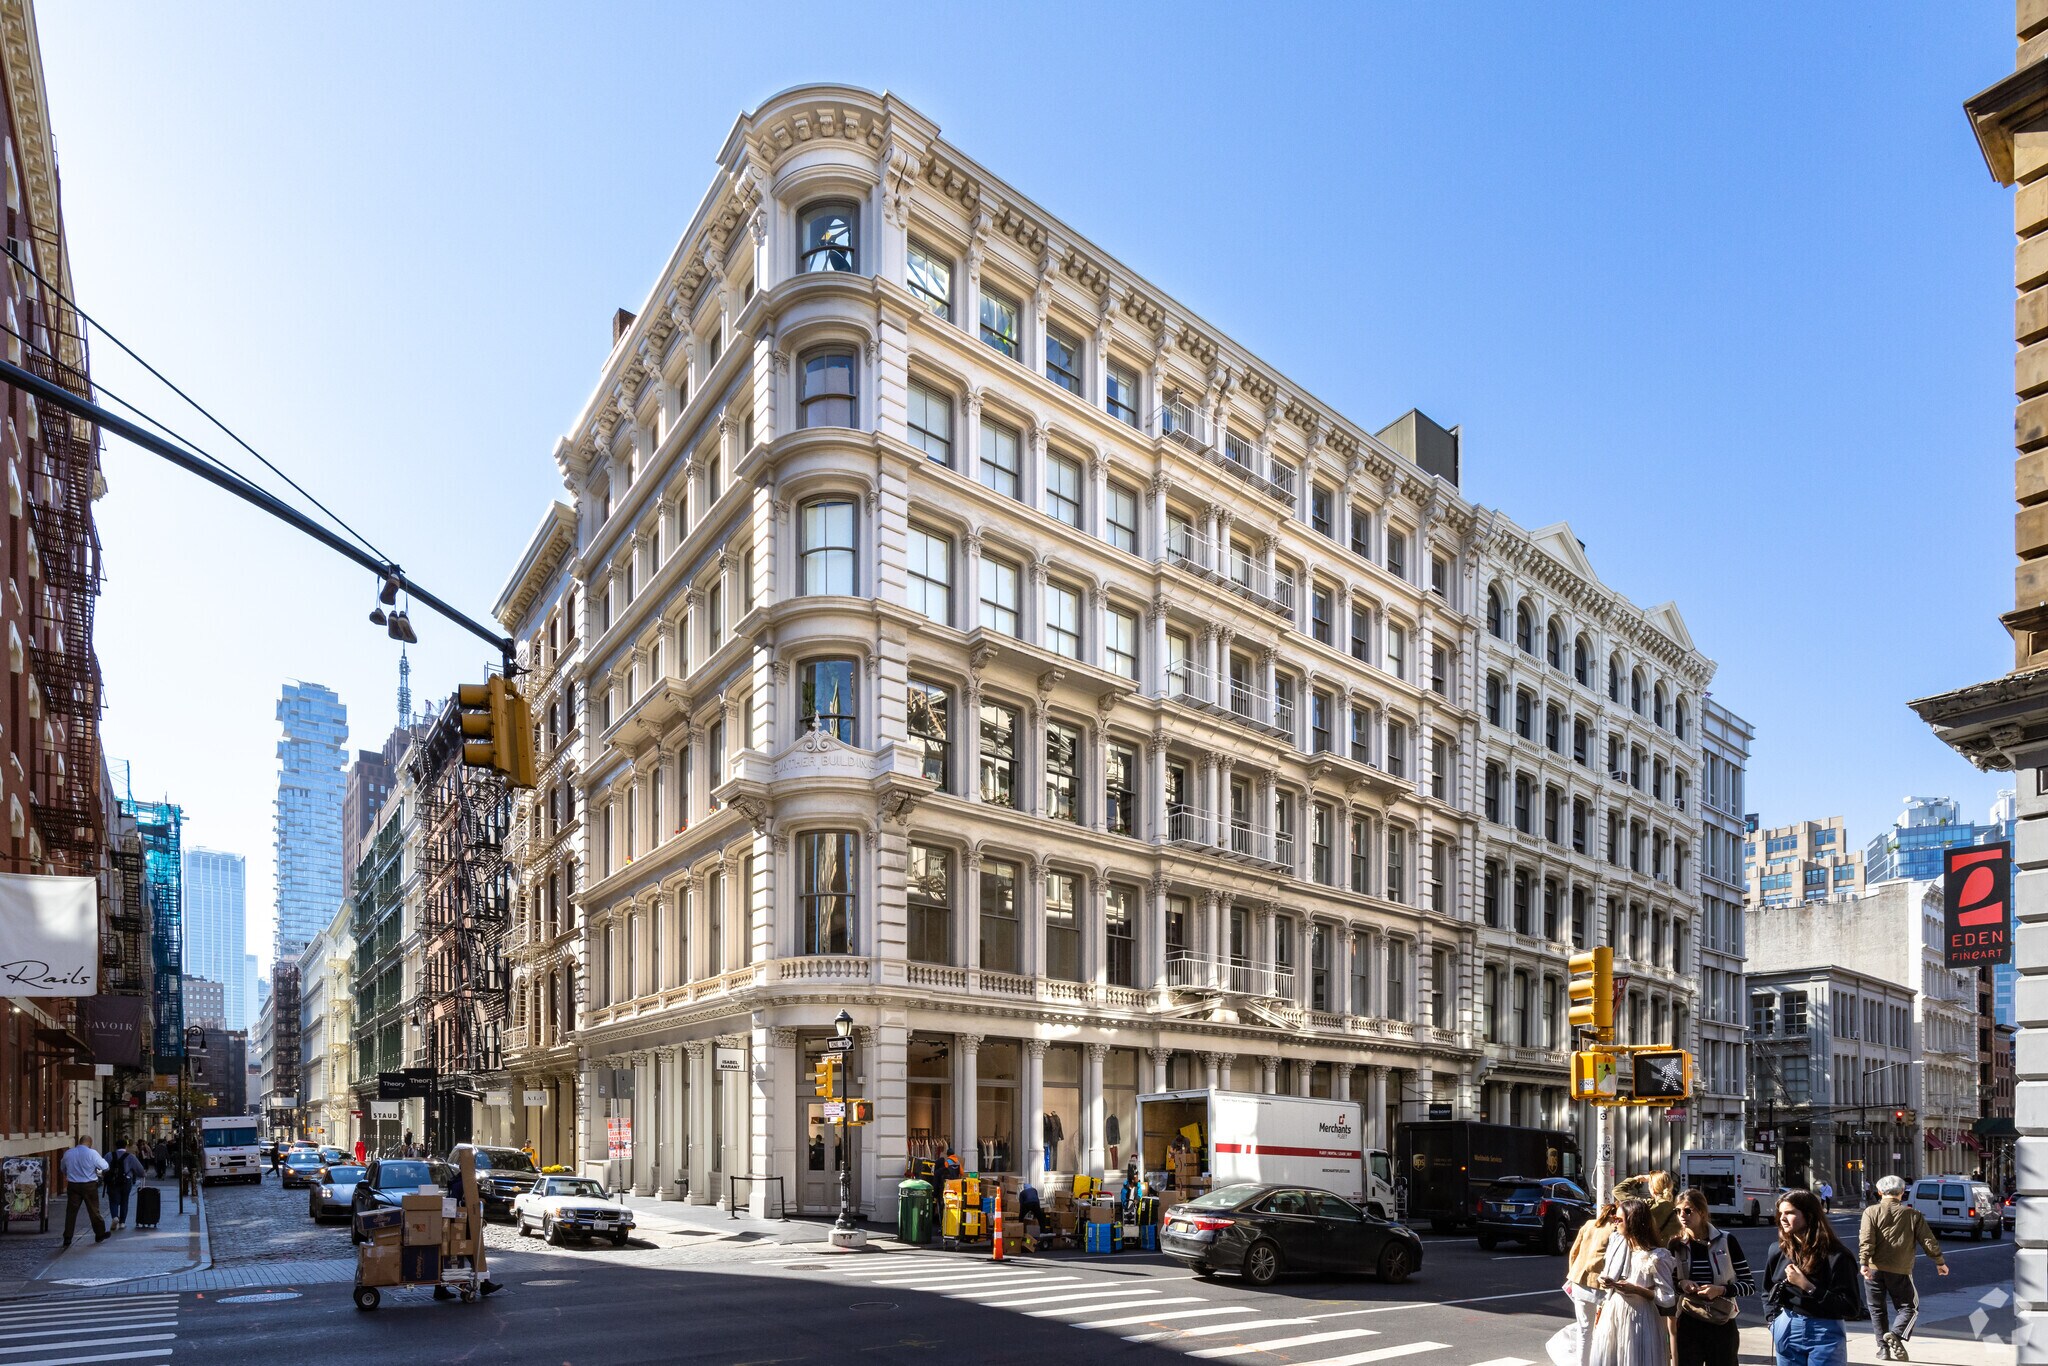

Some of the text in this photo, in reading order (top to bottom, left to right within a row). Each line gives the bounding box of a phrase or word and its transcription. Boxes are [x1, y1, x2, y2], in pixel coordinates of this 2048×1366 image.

[821, 755, 879, 770] BUILDING
[1952, 930, 2003, 948] EDEN
[0, 960, 91, 989] Rails
[85, 1021, 133, 1031] SAVOIR
[1319, 1122, 1352, 1134] Merchants
